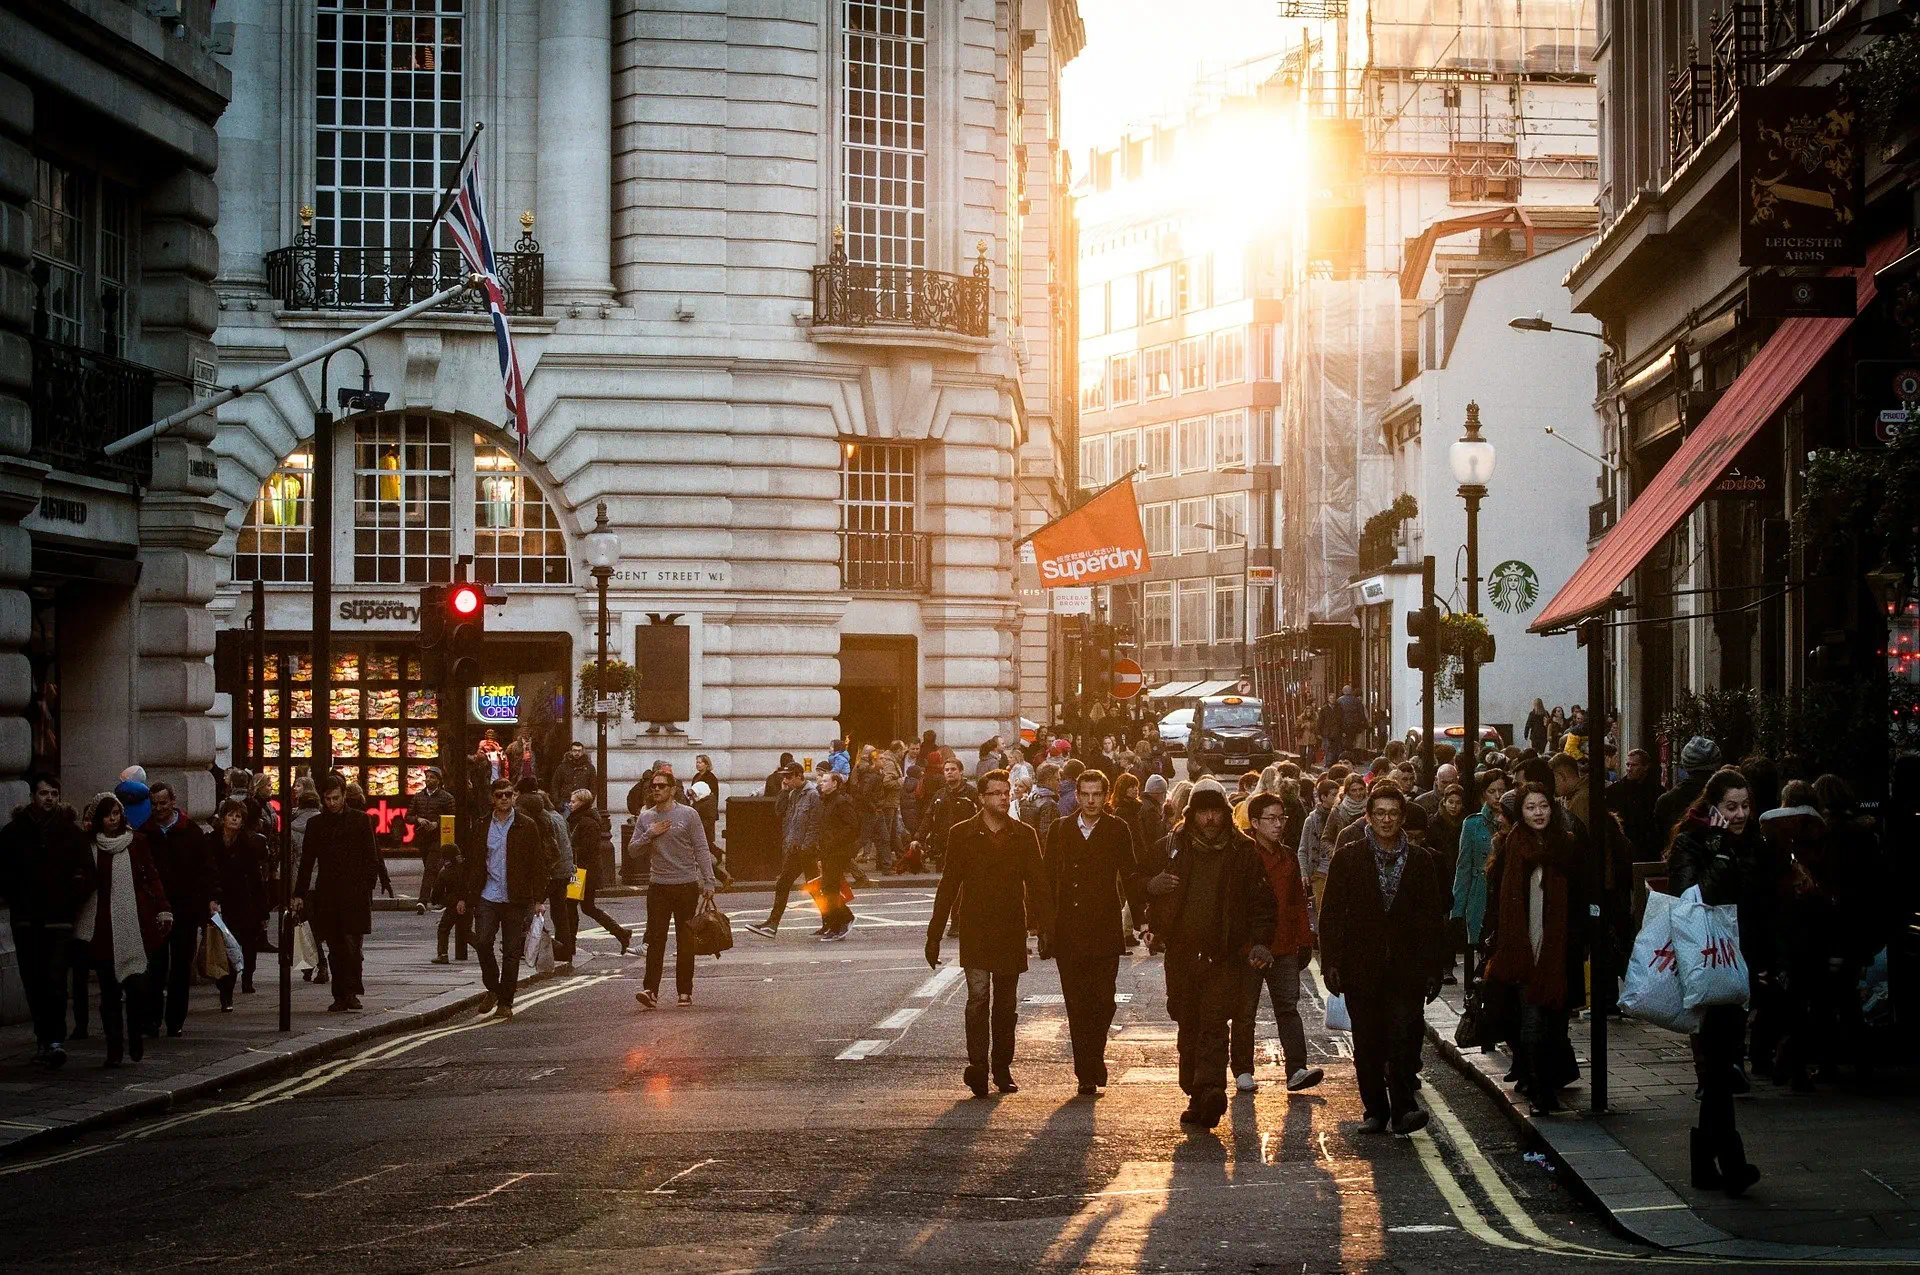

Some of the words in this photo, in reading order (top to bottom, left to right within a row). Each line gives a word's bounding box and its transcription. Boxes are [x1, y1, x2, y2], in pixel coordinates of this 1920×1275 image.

[1765, 237, 1843, 248] LEICESTER
[1784, 251, 1825, 261] ARMS
[1041, 547, 1143, 580] Superdry
[657, 571, 701, 581] STREET
[340, 601, 421, 624] Superdry
[1700, 935, 1739, 970] H&M
